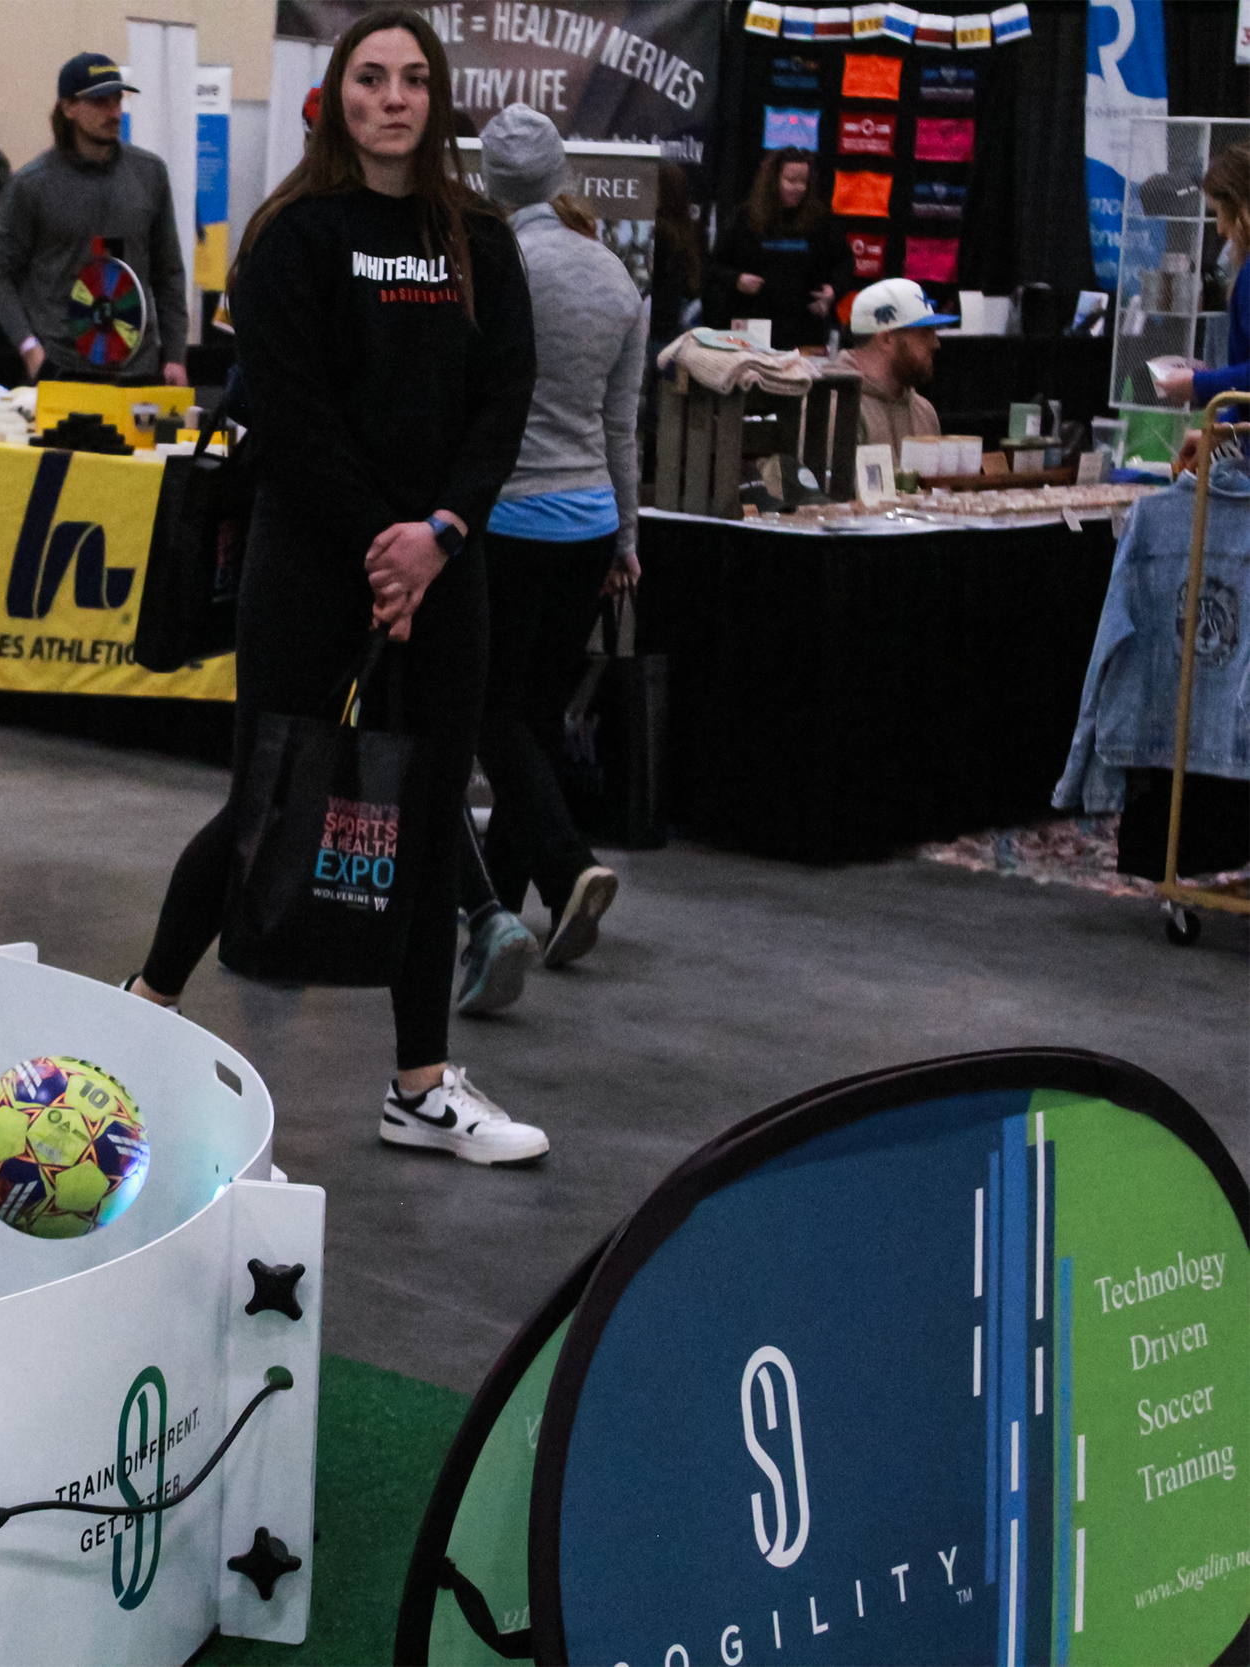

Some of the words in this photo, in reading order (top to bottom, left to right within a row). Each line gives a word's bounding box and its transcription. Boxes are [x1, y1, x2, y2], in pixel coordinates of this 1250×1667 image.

[493, 2, 604, 60] HEALTHY
[599, 26, 705, 111] NERVES
[518, 69, 568, 112] LIFE
[583, 177, 640, 199] FREE
[352, 250, 449, 282] WHITEHALL
[324, 811, 399, 842] SPORTS
[337, 834, 397, 858] HEALTH
[314, 847, 395, 890] EXPO
[313, 887, 370, 905] WOLVERINE
[79, 1079, 110, 1110] 10
[1093, 1251, 1226, 1314] Technology
[1129, 1322, 1208, 1371] Driven
[1137, 1385, 1214, 1436] Soccer
[55, 1463, 116, 1503] TRAIN
[123, 1407, 200, 1480] DIFFERENT.
[1137, 1443, 1236, 1503] Training
[80, 1515, 118, 1553] GET
[613, 1546, 958, 1667] OGILITY
